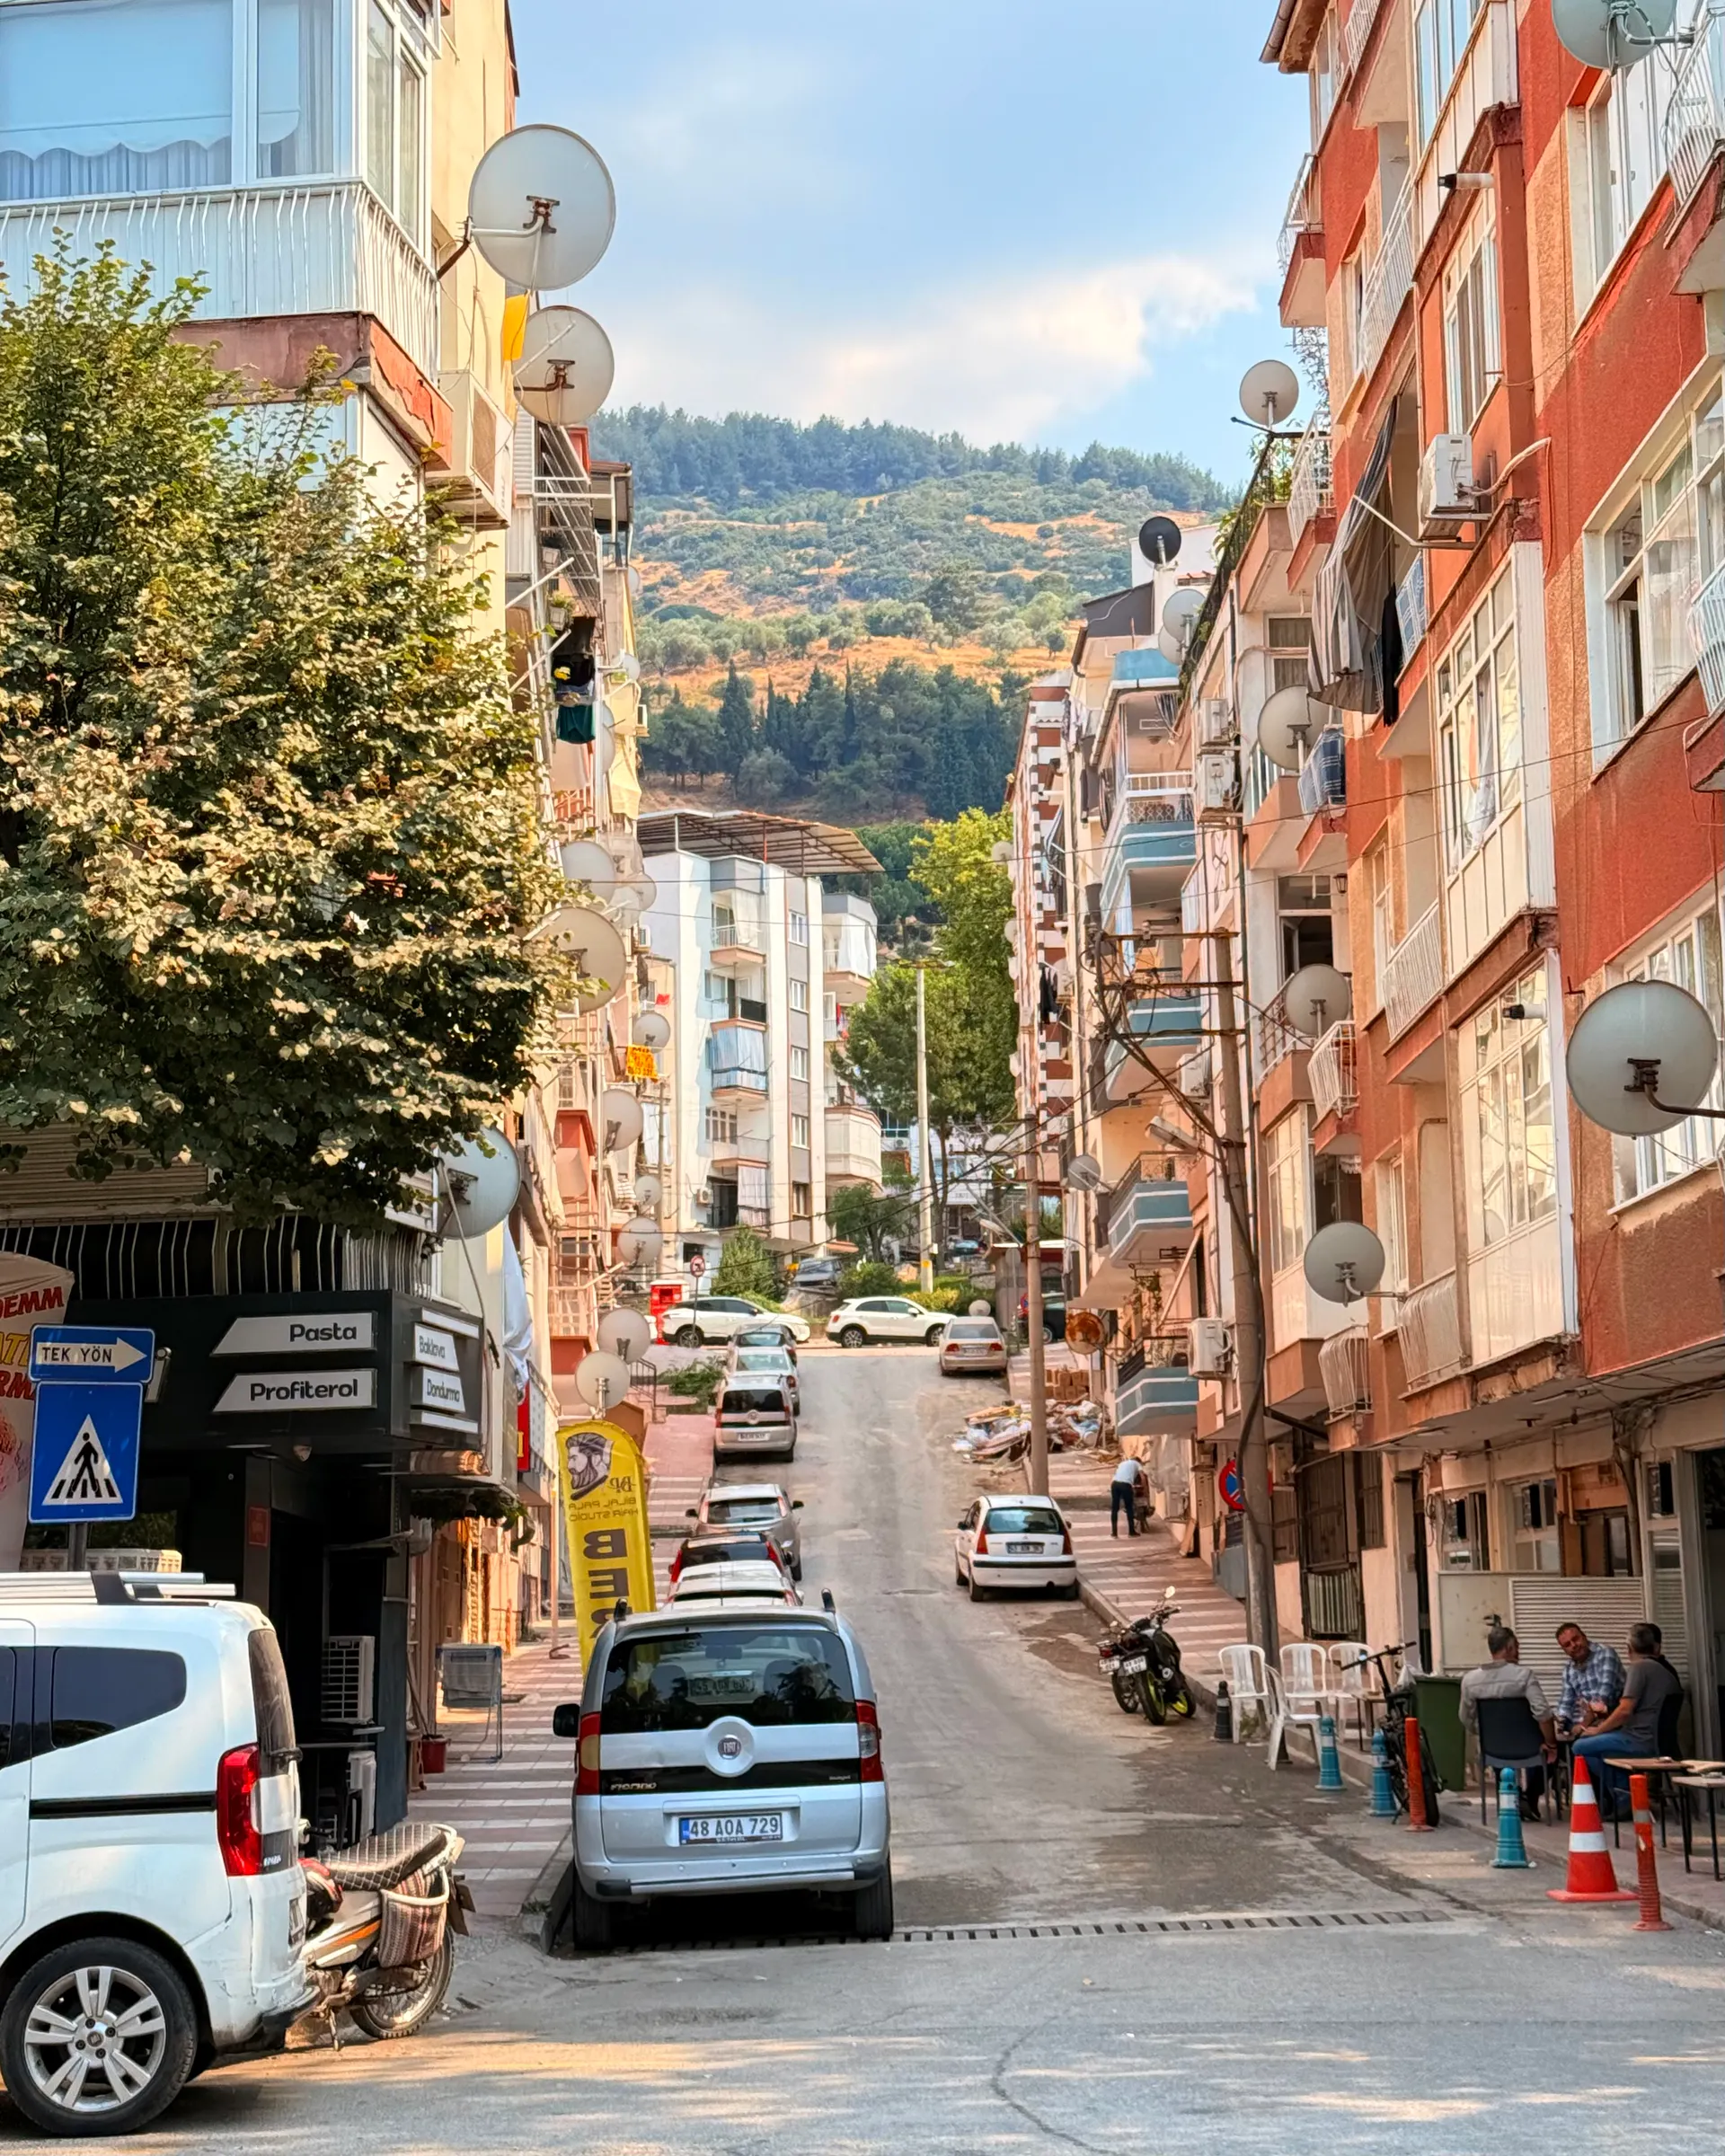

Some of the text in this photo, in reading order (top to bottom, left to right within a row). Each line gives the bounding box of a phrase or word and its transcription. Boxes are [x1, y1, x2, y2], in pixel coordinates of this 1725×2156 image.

[0, 1286, 65, 1319] EMM
[289, 1322, 358, 1342] Pasta
[42, 1348, 71, 1362] TEK
[80, 1346, 112, 1363] YÖN
[419, 1335, 446, 1359] Baklava
[250, 1379, 358, 1401] Profiterol
[427, 1378, 460, 1403] Dondurma
[690, 1816, 779, 1837] 48 AOA 729
